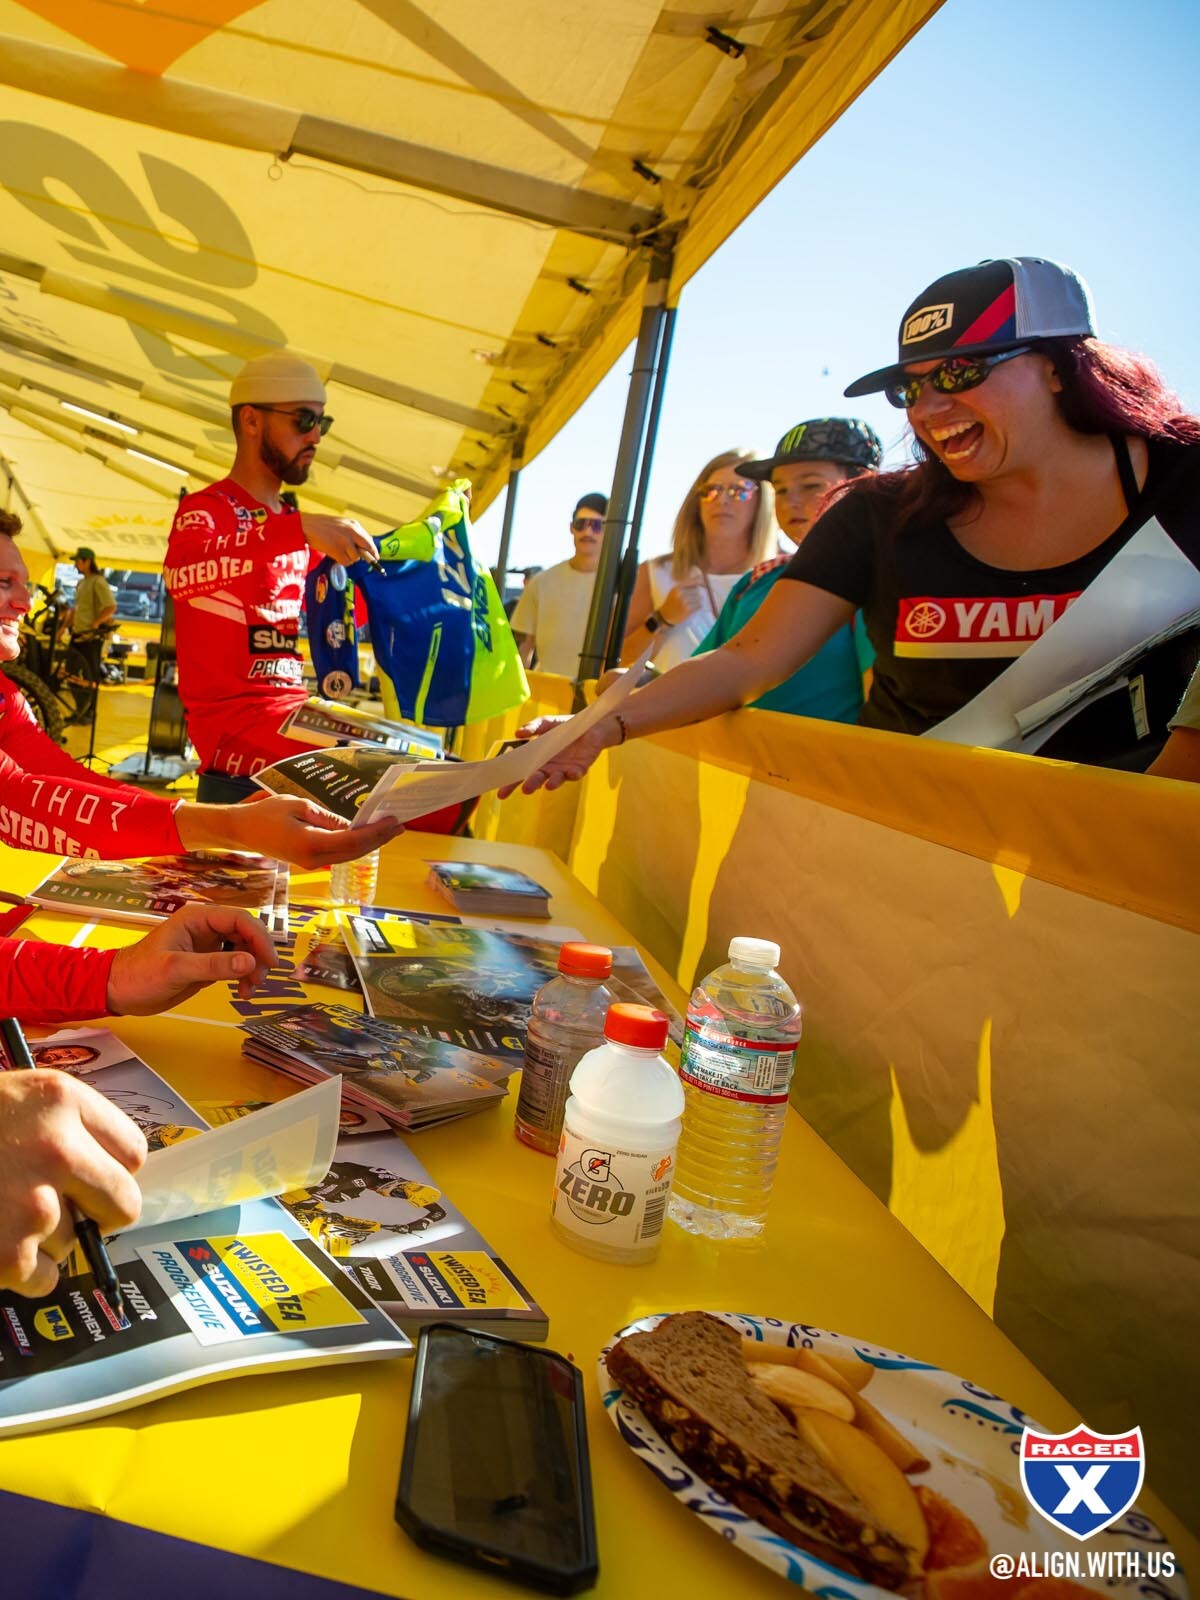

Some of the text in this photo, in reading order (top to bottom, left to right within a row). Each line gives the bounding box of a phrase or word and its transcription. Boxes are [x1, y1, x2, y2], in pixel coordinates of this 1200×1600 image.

[907, 309, 946, 339] 100%
[220, 556, 253, 579] TEA
[955, 599, 1081, 639] YAM
[559, 1167, 636, 1217] ZERO
[152, 1250, 226, 1331] PROGRESSIVE
[201, 1263, 261, 1326] SUZUKI
[224, 1239, 290, 1296] TWISTED
[274, 1292, 307, 1323] TEA
[359, 1266, 383, 1292] THOR
[419, 1265, 453, 1305] SUZUKI
[438, 1253, 488, 1305] TWISTED TEA
[69, 1290, 106, 1342] MAYHEM
[120, 1280, 158, 1322] THOR
[4, 1306, 30, 1348] NOLEEN
